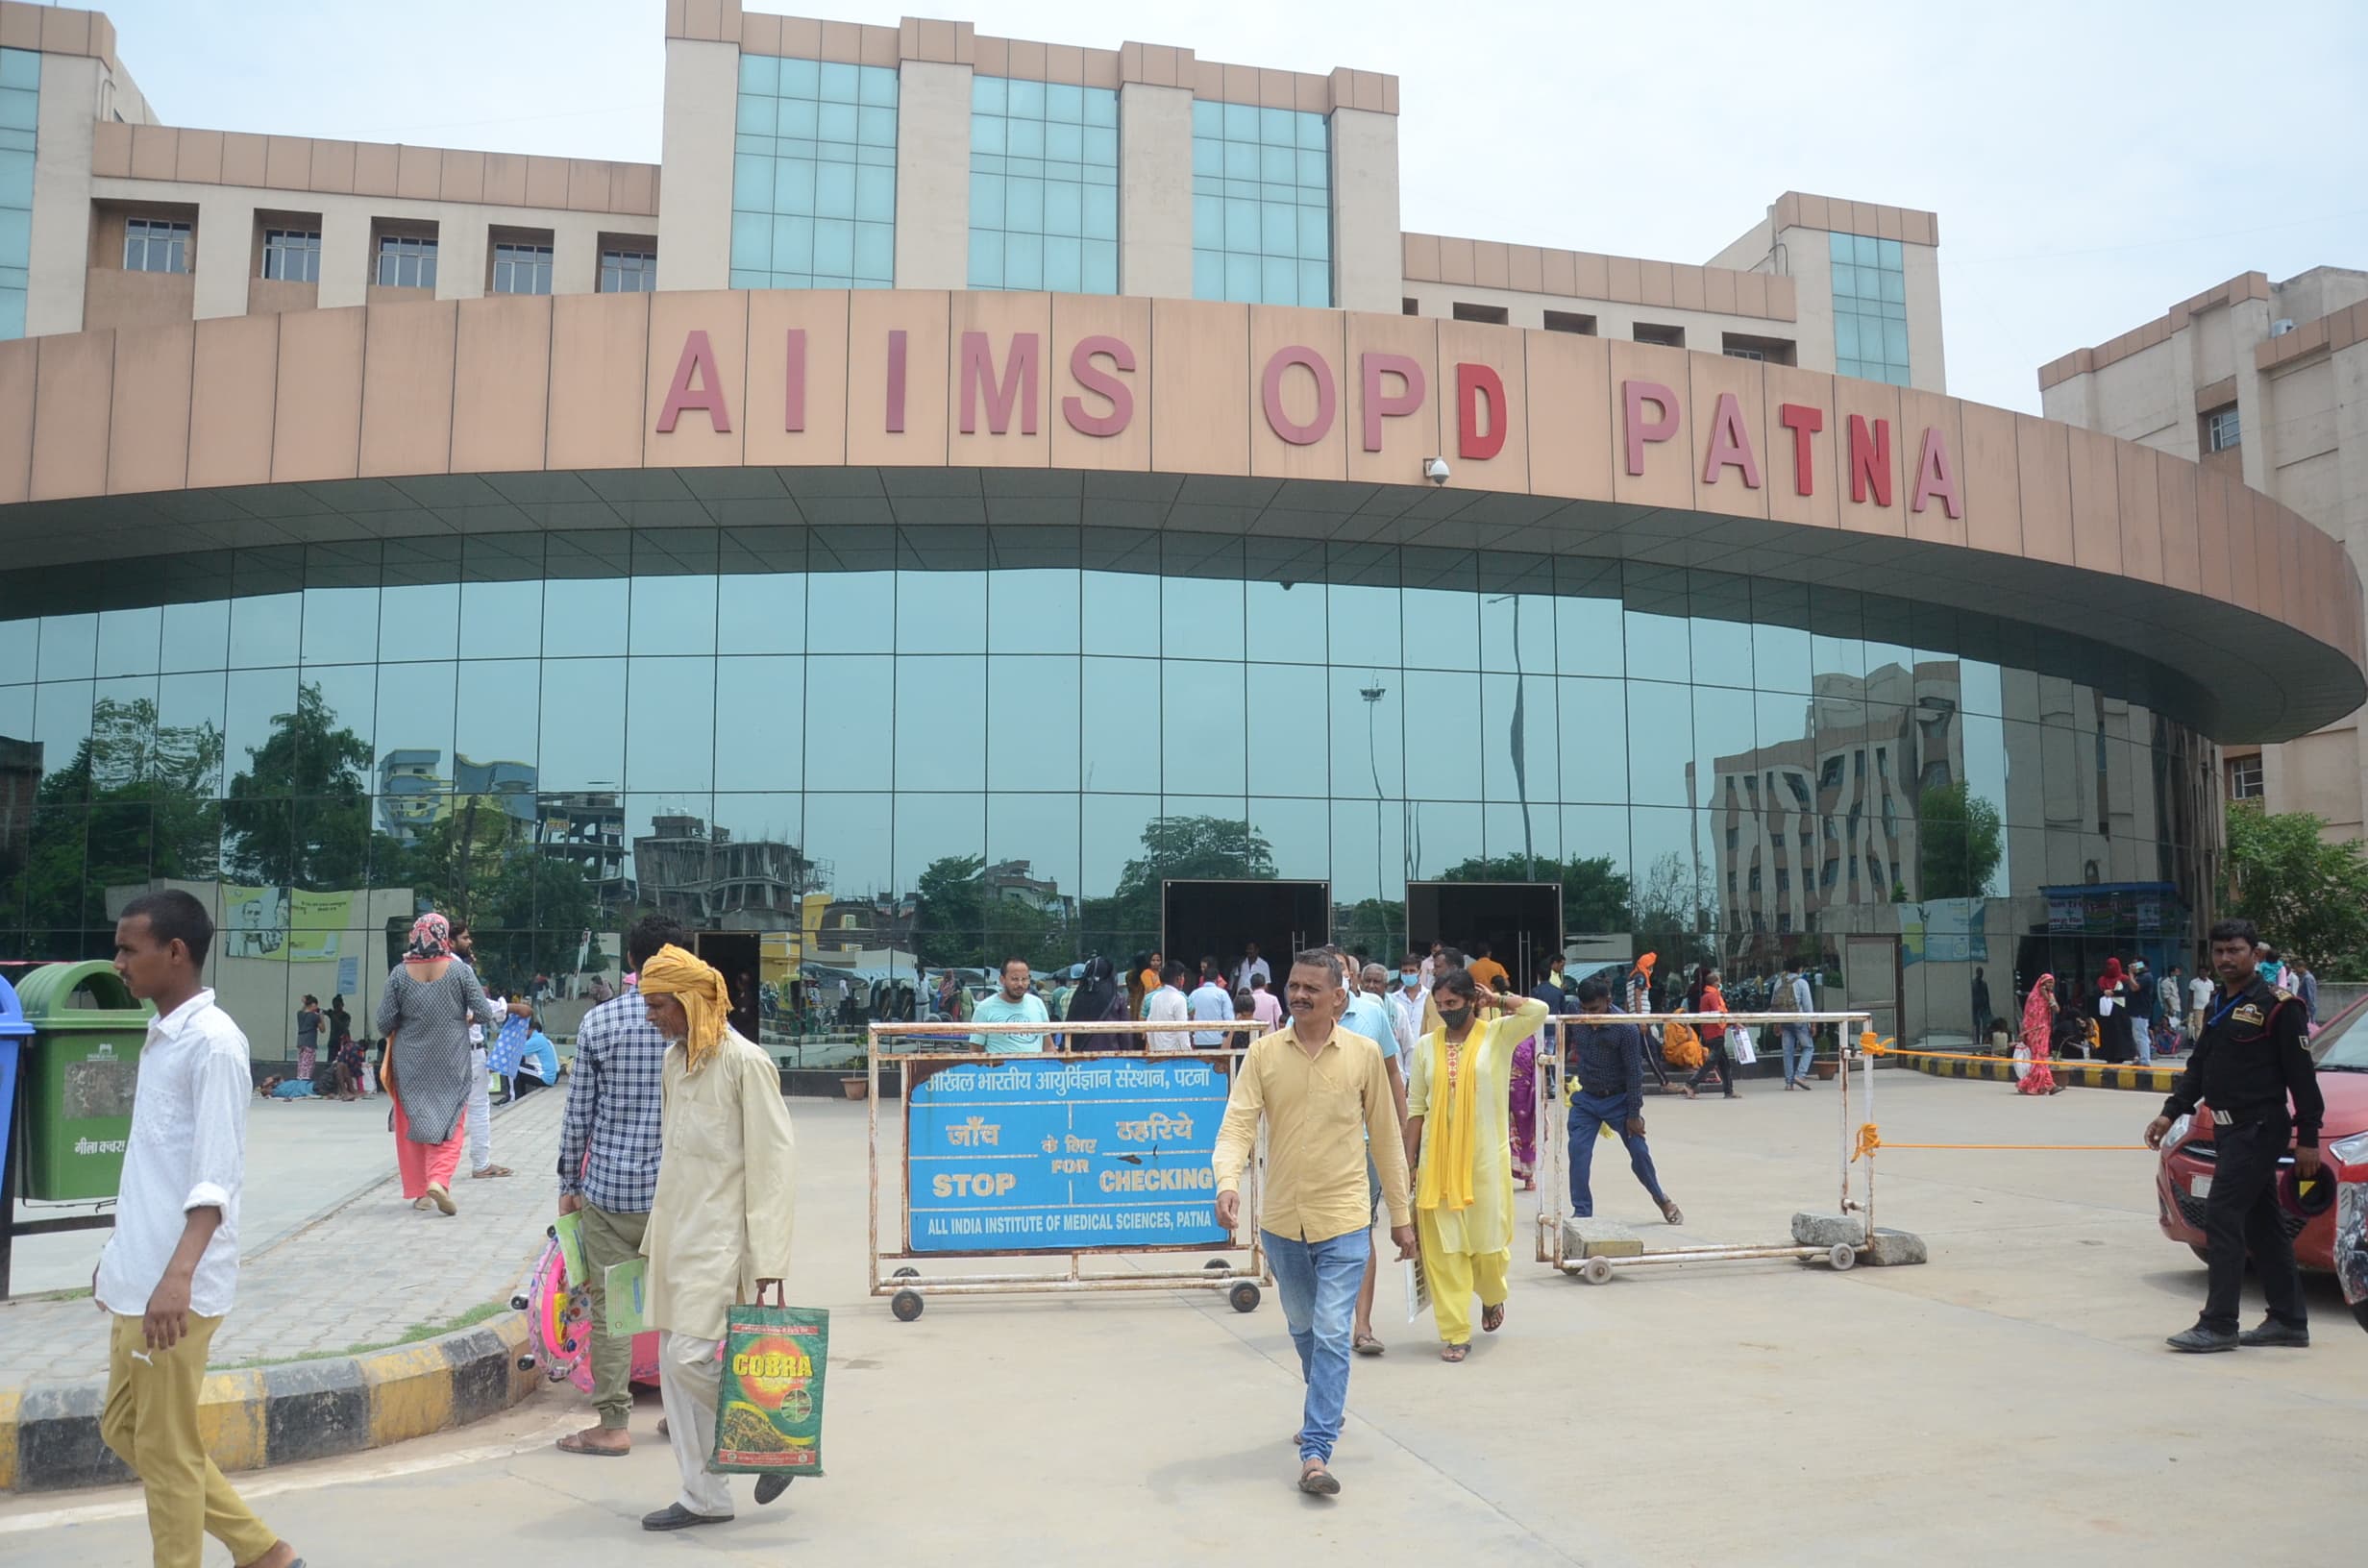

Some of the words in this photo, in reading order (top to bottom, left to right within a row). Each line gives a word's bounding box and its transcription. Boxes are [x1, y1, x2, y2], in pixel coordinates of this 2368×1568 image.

[656, 329, 1136, 437] AIIMS
[1263, 345, 1507, 459] OPD
[1624, 380, 1961, 519] PATNA
[978, 1066, 1031, 1090] भारतीय
[1035, 1064, 1113, 1096] आयुर्विज्ञान
[1115, 1063, 1171, 1090] संस्थान,
[1173, 1067, 1210, 1087] पटना
[75, 1137, 98, 1155] गीला
[945, 1115, 1000, 1146] जाँच
[1041, 1134, 1058, 1153] के
[1065, 1134, 1098, 1153] लिए
[1116, 1112, 1194, 1142] ठहरिये
[932, 1172, 1017, 1197] STOP
[1051, 1159, 1090, 1174] FOR
[1098, 1167, 1214, 1192] CHECKING
[928, 1217, 949, 1235] ALL
[950, 1217, 982, 1235] INDIA
[985, 1215, 1044, 1234] INSTITUTE
[1046, 1214, 1061, 1232] OF
[1063, 1213, 1114, 1231] MEDICAL
[1116, 1212, 1174, 1230] SCIENCES,
[1176, 1211, 1212, 1228] PATNA
[732, 1353, 814, 1378] COBRA
